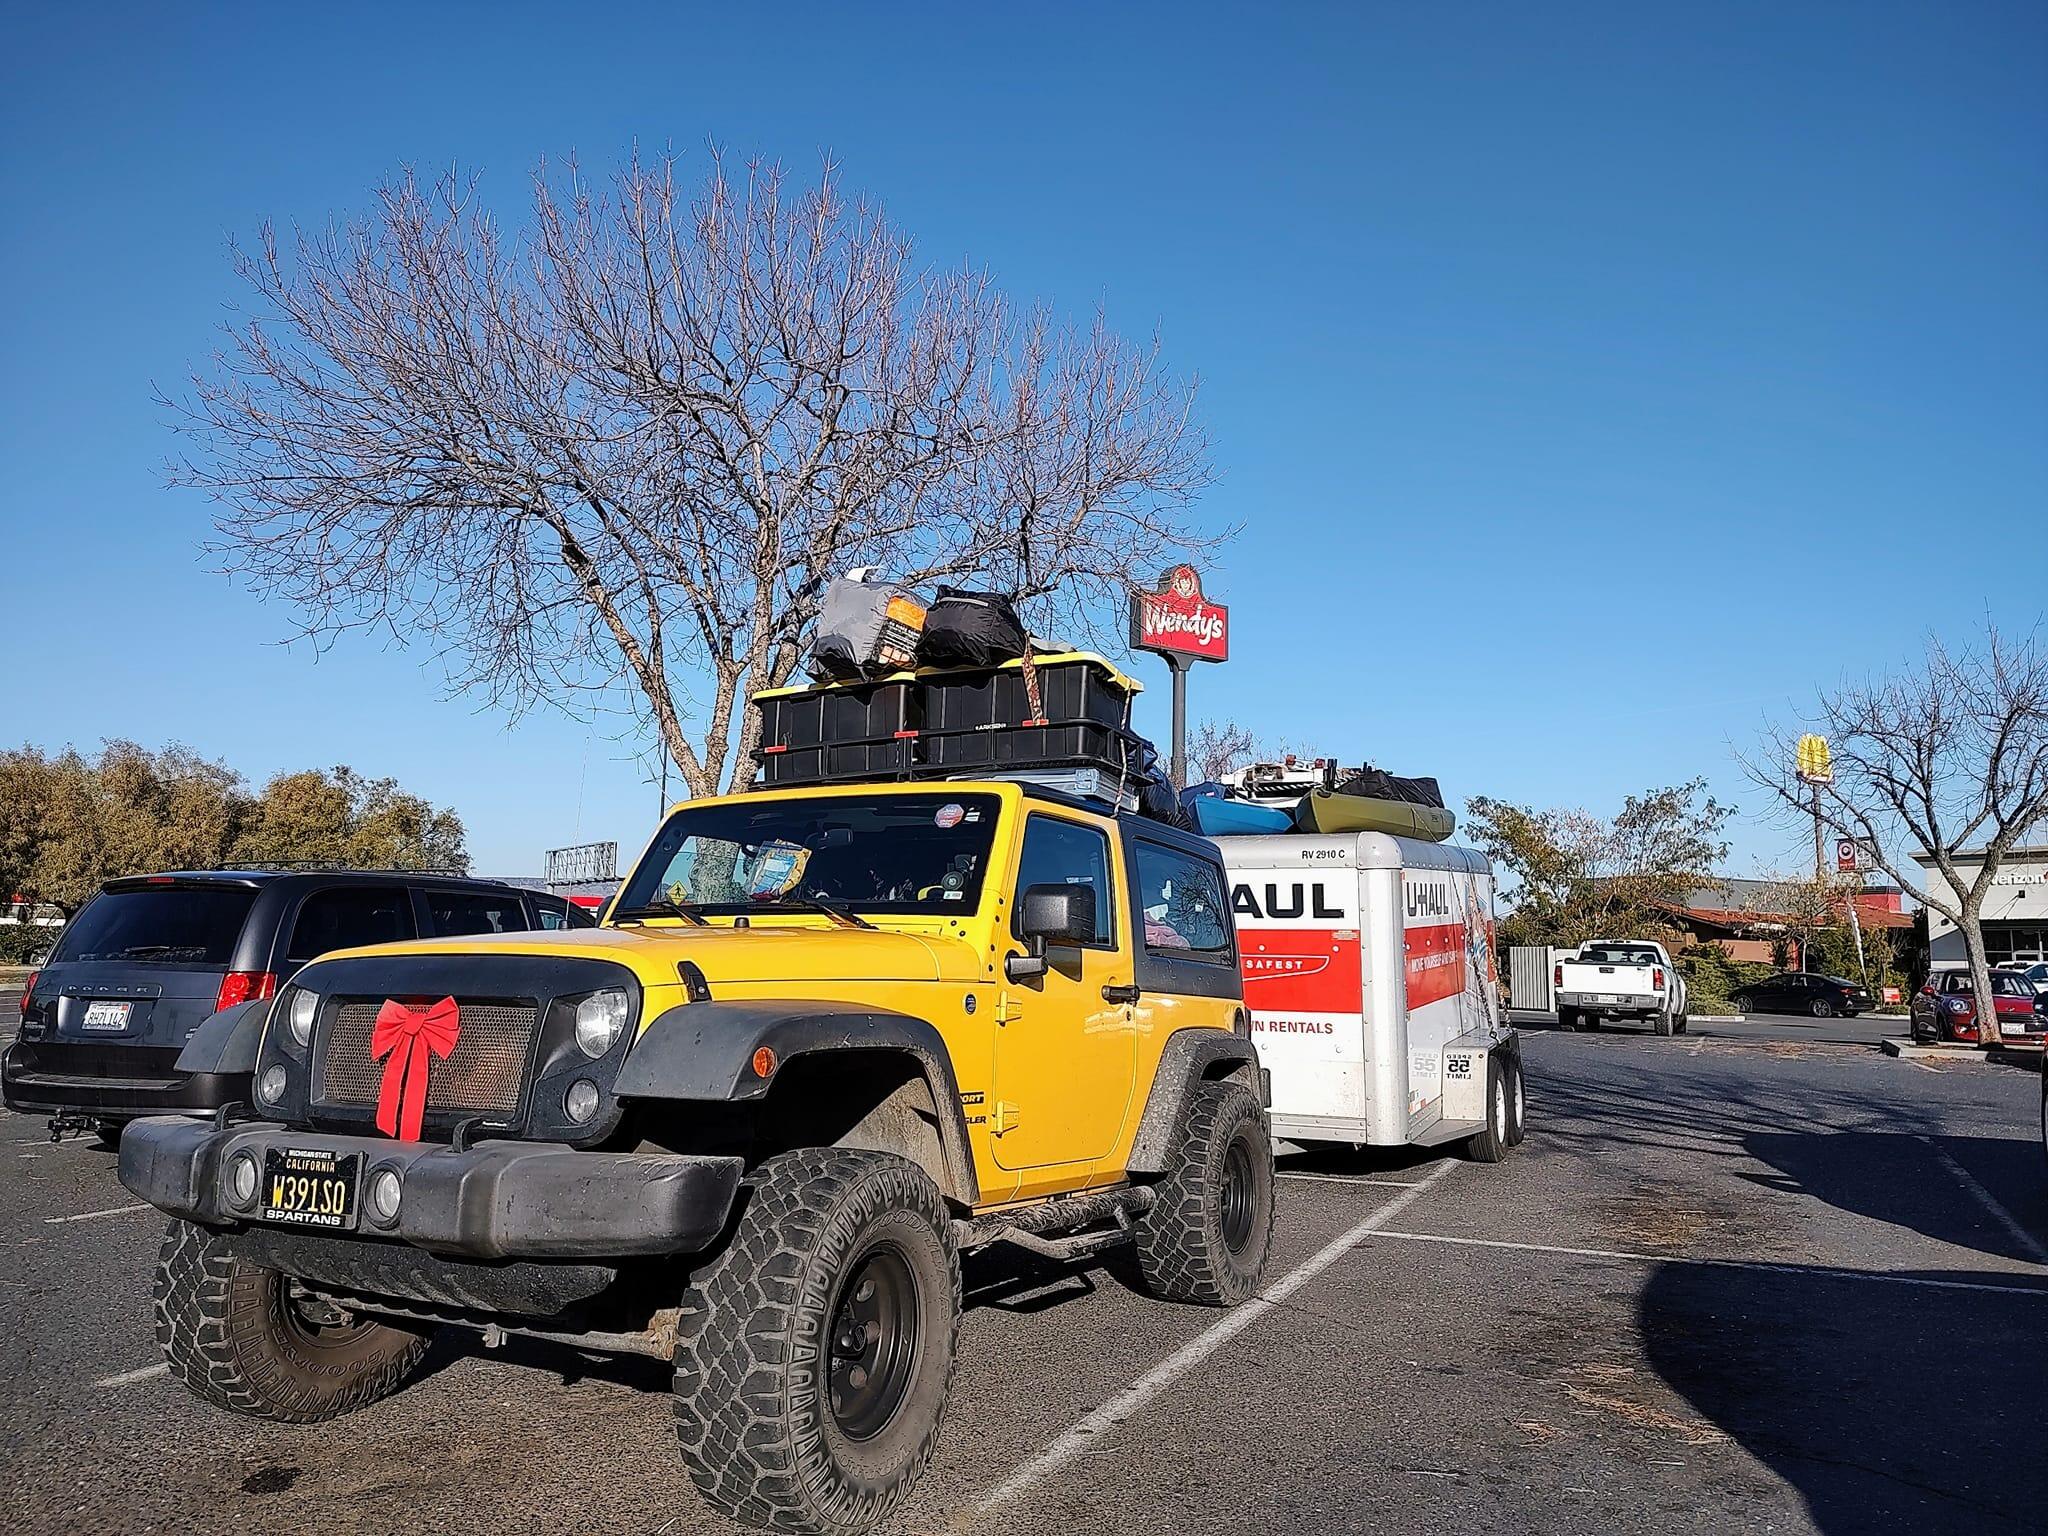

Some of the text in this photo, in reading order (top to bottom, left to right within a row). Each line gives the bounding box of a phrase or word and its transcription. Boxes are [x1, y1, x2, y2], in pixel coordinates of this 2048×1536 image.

[1144, 602, 1224, 646] Wendy's
[1301, 849, 1346, 860] RV 2910 C
[1231, 883, 1345, 919] AUL
[1245, 959, 1303, 970] SAFEST
[1269, 1021, 1334, 1035] RENTALS
[286, 1158, 335, 1173] CALIFORNIA
[266, 1209, 341, 1226] SPARTANS
